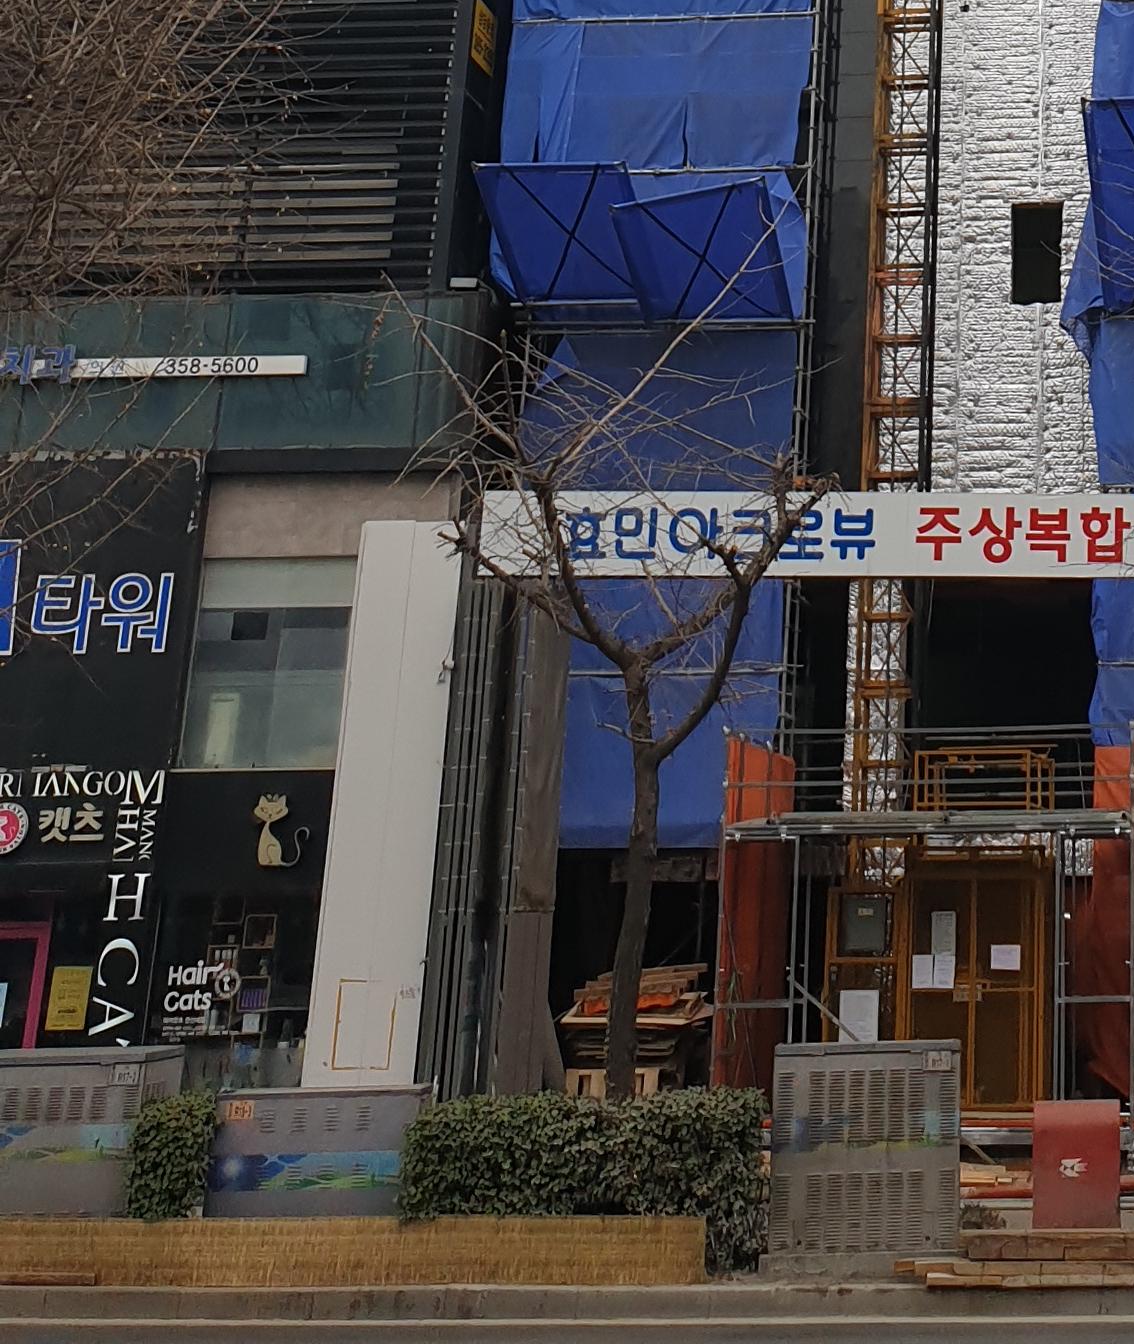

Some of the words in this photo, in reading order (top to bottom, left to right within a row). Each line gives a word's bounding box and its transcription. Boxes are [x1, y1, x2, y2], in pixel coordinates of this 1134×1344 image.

[0, 343, 77, 385] 치과
[164, 356, 259, 375] 358-5600
[565, 506, 877, 561] 효민아크로뷰
[915, 506, 1131, 564] 주상복합
[31, 572, 174, 655] 타워
[38, 802, 105, 843] 캣츠
[167, 959, 225, 986] Hair
[163, 989, 212, 1013] Cats
